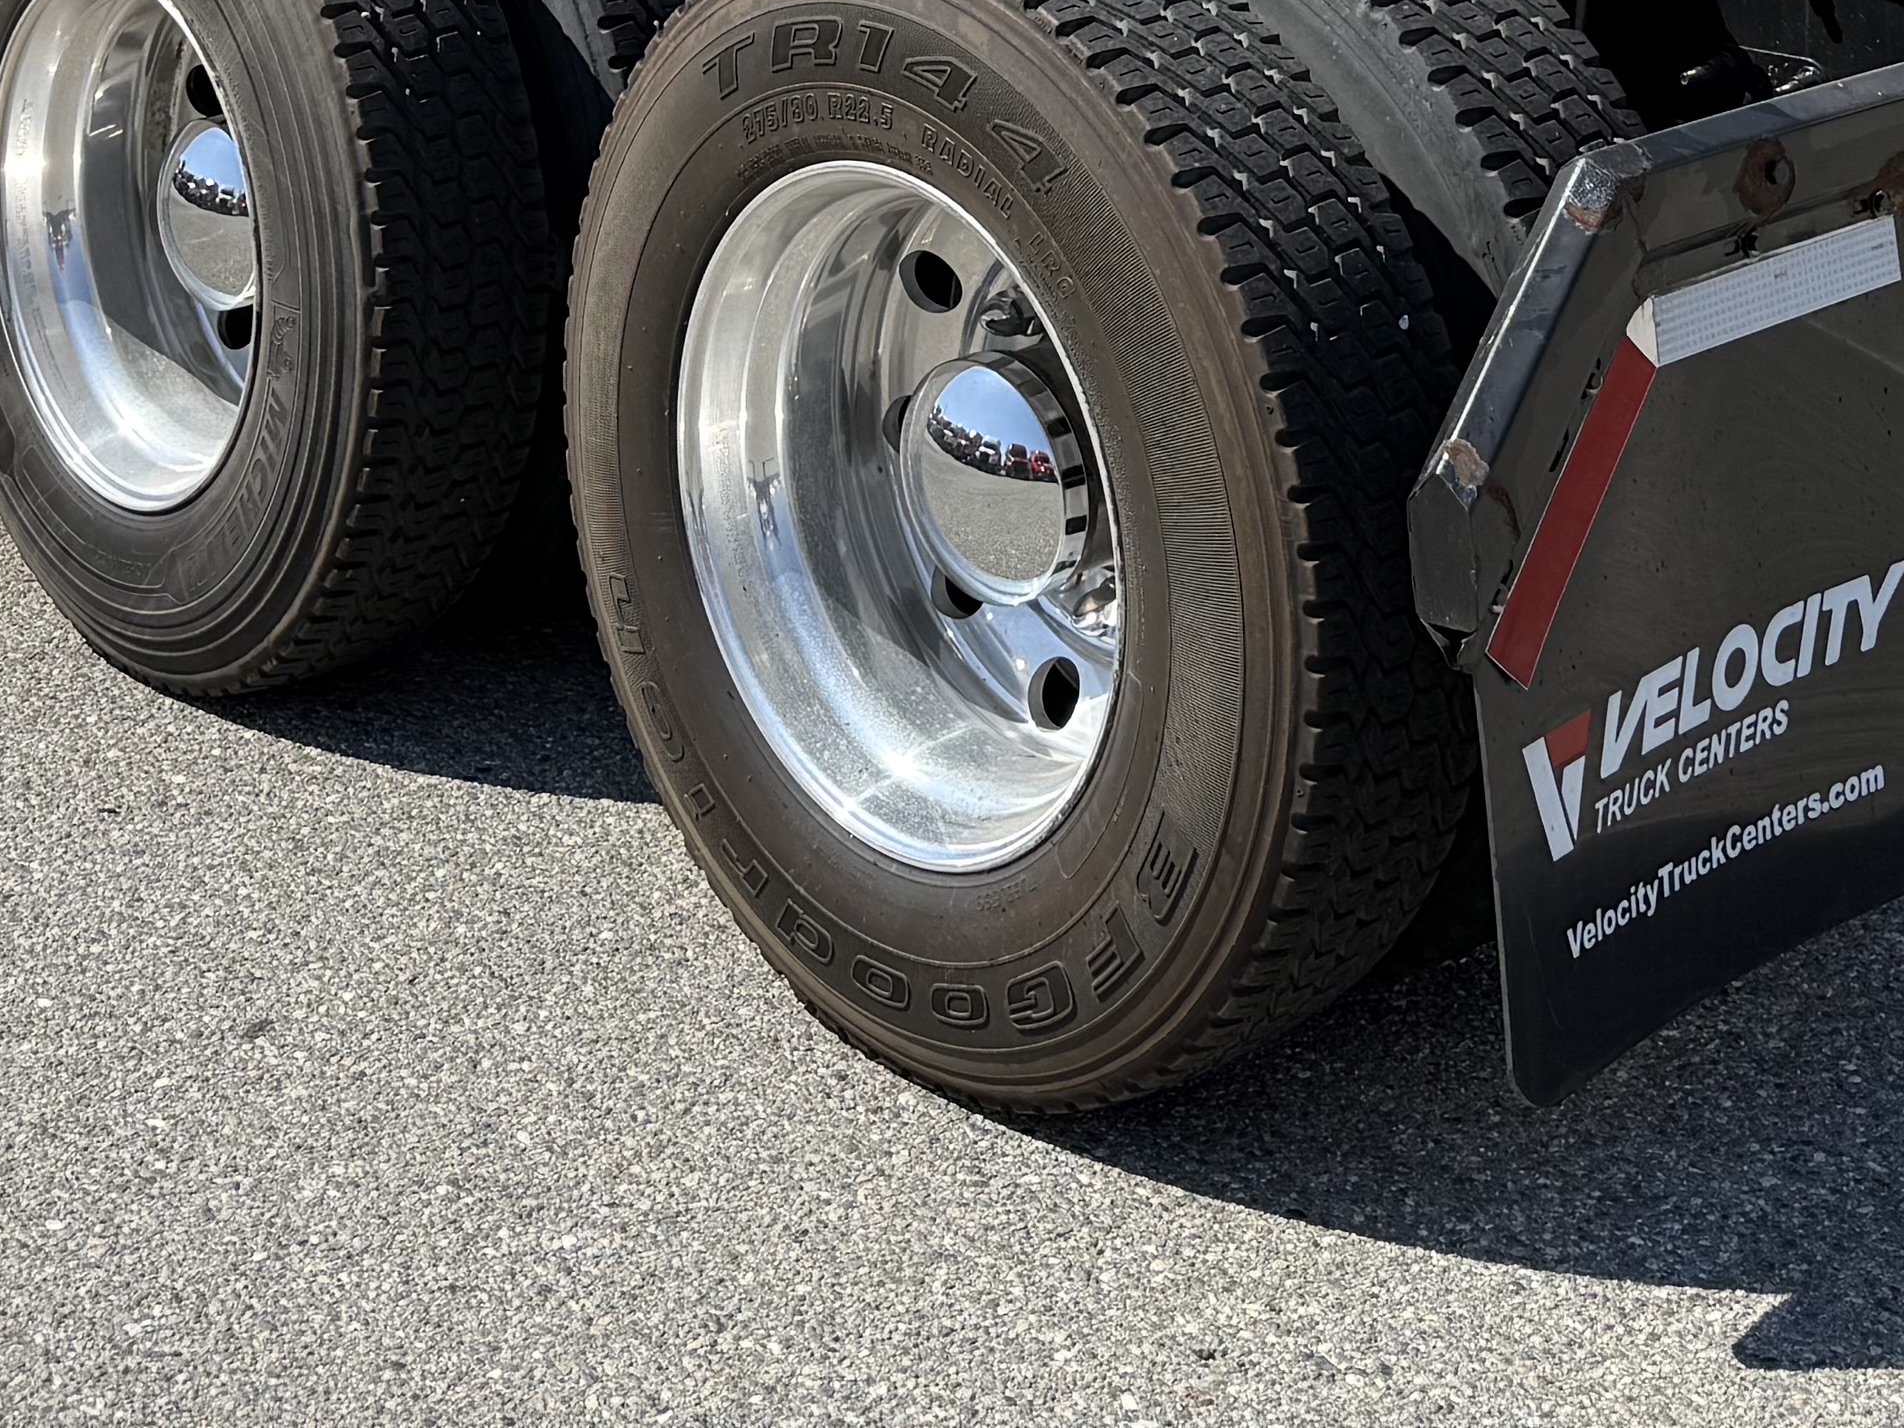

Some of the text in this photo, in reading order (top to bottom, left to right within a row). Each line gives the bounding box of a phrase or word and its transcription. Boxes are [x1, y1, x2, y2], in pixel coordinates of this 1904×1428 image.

[701, 15, 1069, 194] TR144
[742, 92, 819, 145] 275/80
[827, 91, 894, 130] R22.5
[920, 123, 1015, 221] RADIAL
[1594, 698, 1790, 835] TRUCK CENTERS
[1566, 763, 1885, 960] VelocityTruckCenters.com
